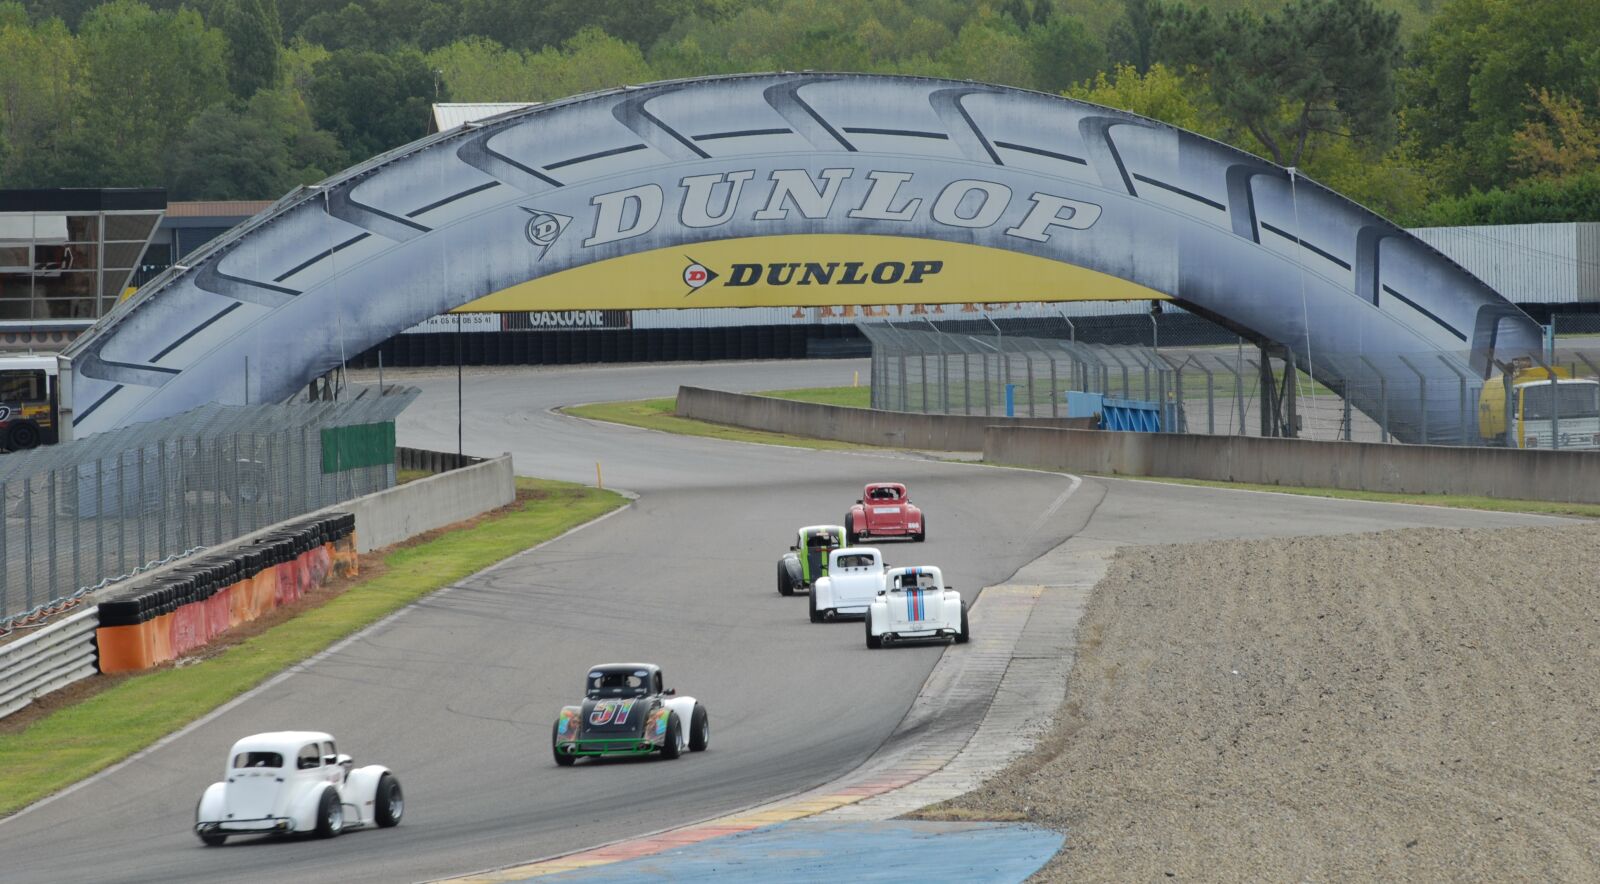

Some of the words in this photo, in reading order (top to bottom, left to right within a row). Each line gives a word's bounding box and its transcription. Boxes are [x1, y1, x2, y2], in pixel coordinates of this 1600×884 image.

[581, 168, 1103, 248] DUNLOP
[723, 260, 944, 287] DUNLOP
[529, 310, 604, 326] GASCOGNE
